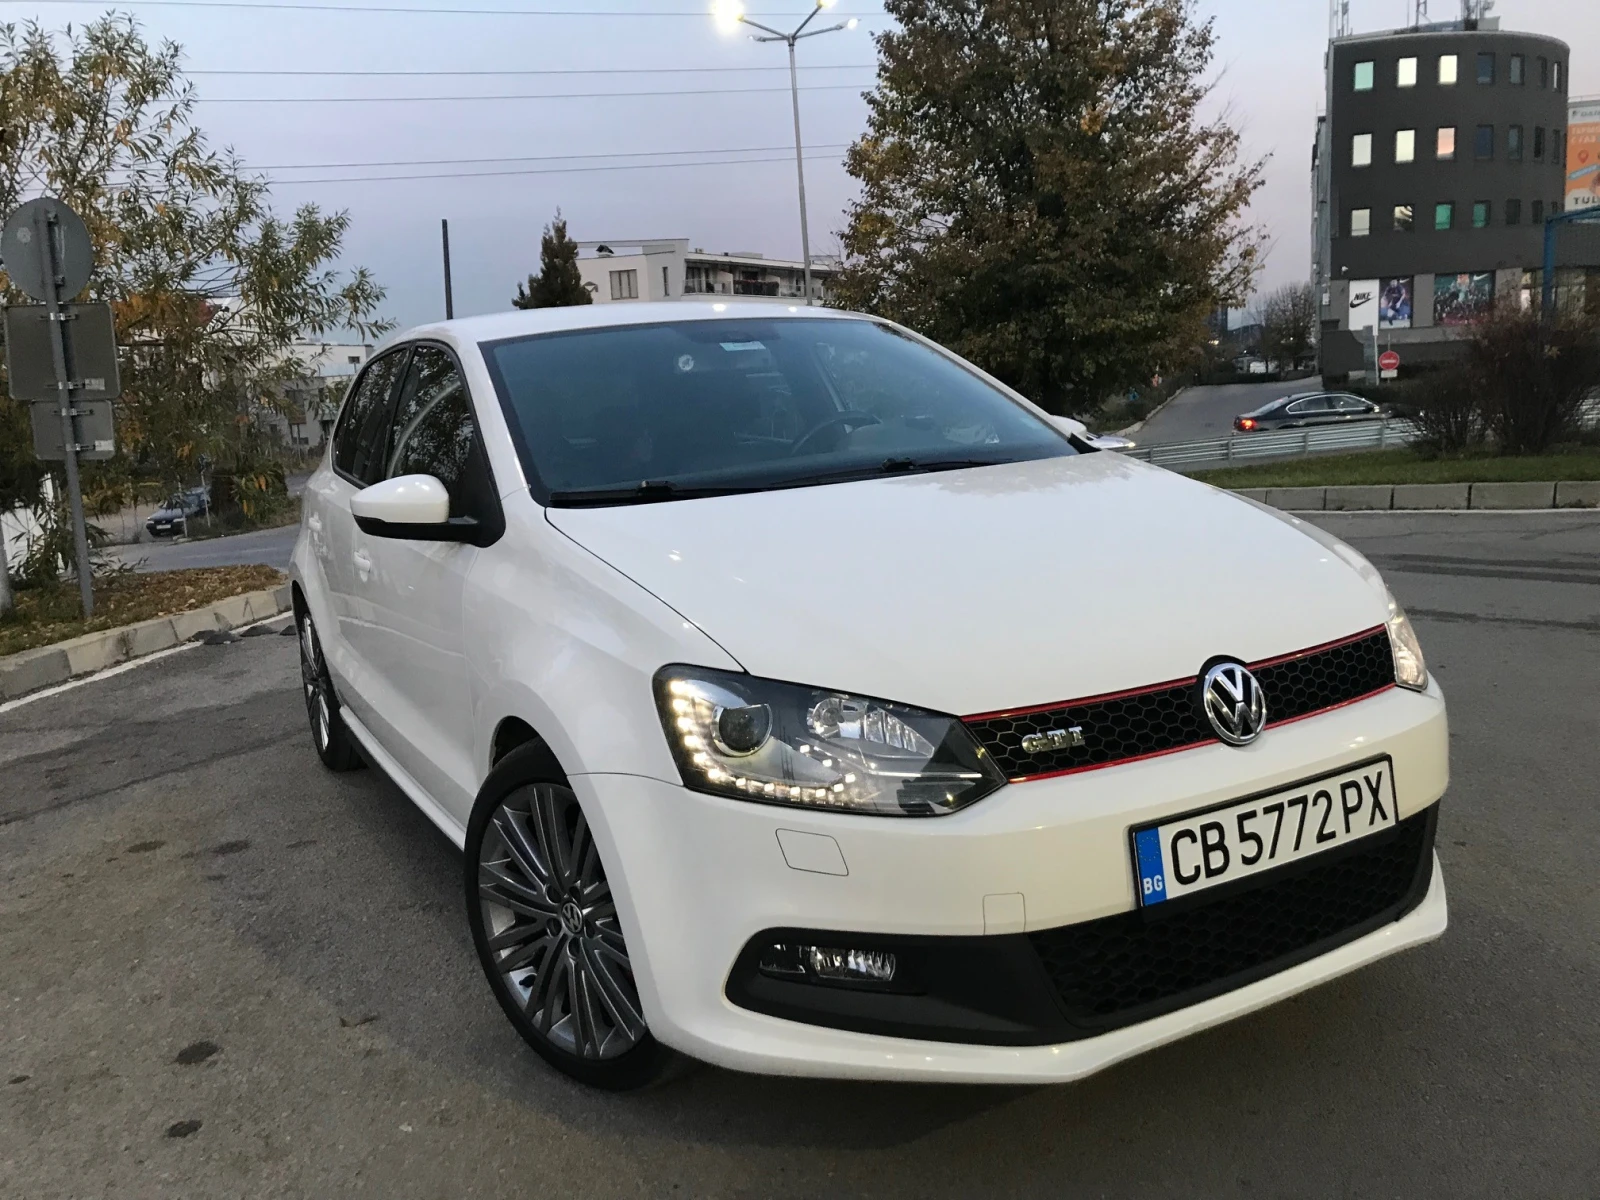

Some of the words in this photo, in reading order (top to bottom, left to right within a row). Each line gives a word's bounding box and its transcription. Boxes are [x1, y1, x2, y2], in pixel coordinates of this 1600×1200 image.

[1353, 290, 1372, 300] NIKE
[1022, 726, 1085, 753] GTI
[1170, 820, 1230, 886] CB
[1236, 788, 1337, 866] 5772
[1339, 770, 1389, 834] PX
[1143, 874, 1163, 895] BG
